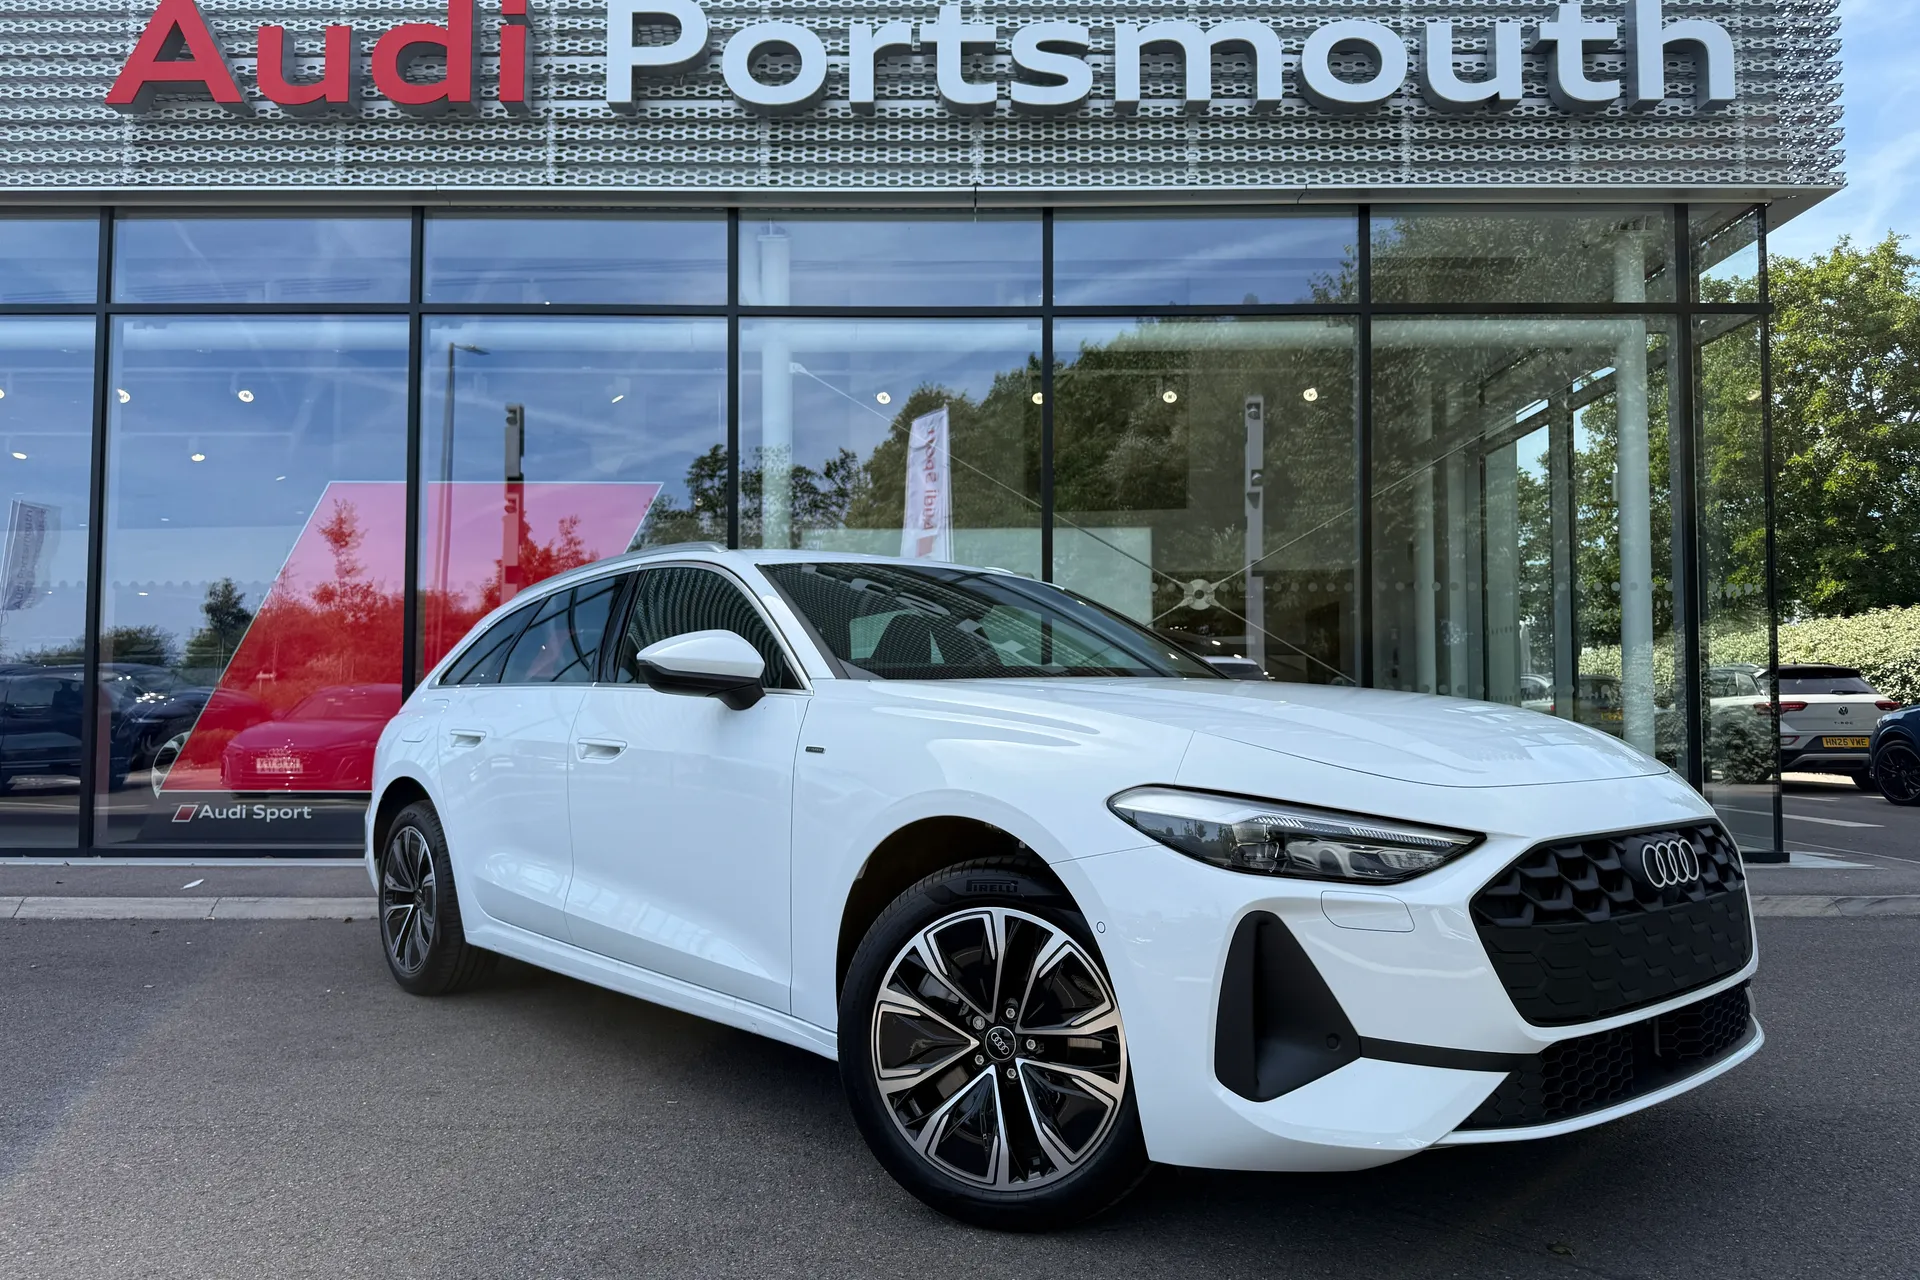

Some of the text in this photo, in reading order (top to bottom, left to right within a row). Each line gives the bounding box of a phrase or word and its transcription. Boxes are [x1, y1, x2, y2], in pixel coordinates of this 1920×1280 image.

[105, 0, 1736, 109] Audi Portsmouth
[198, 804, 312, 823] Audi Sport
[965, 879, 1019, 893] PIRELLI
